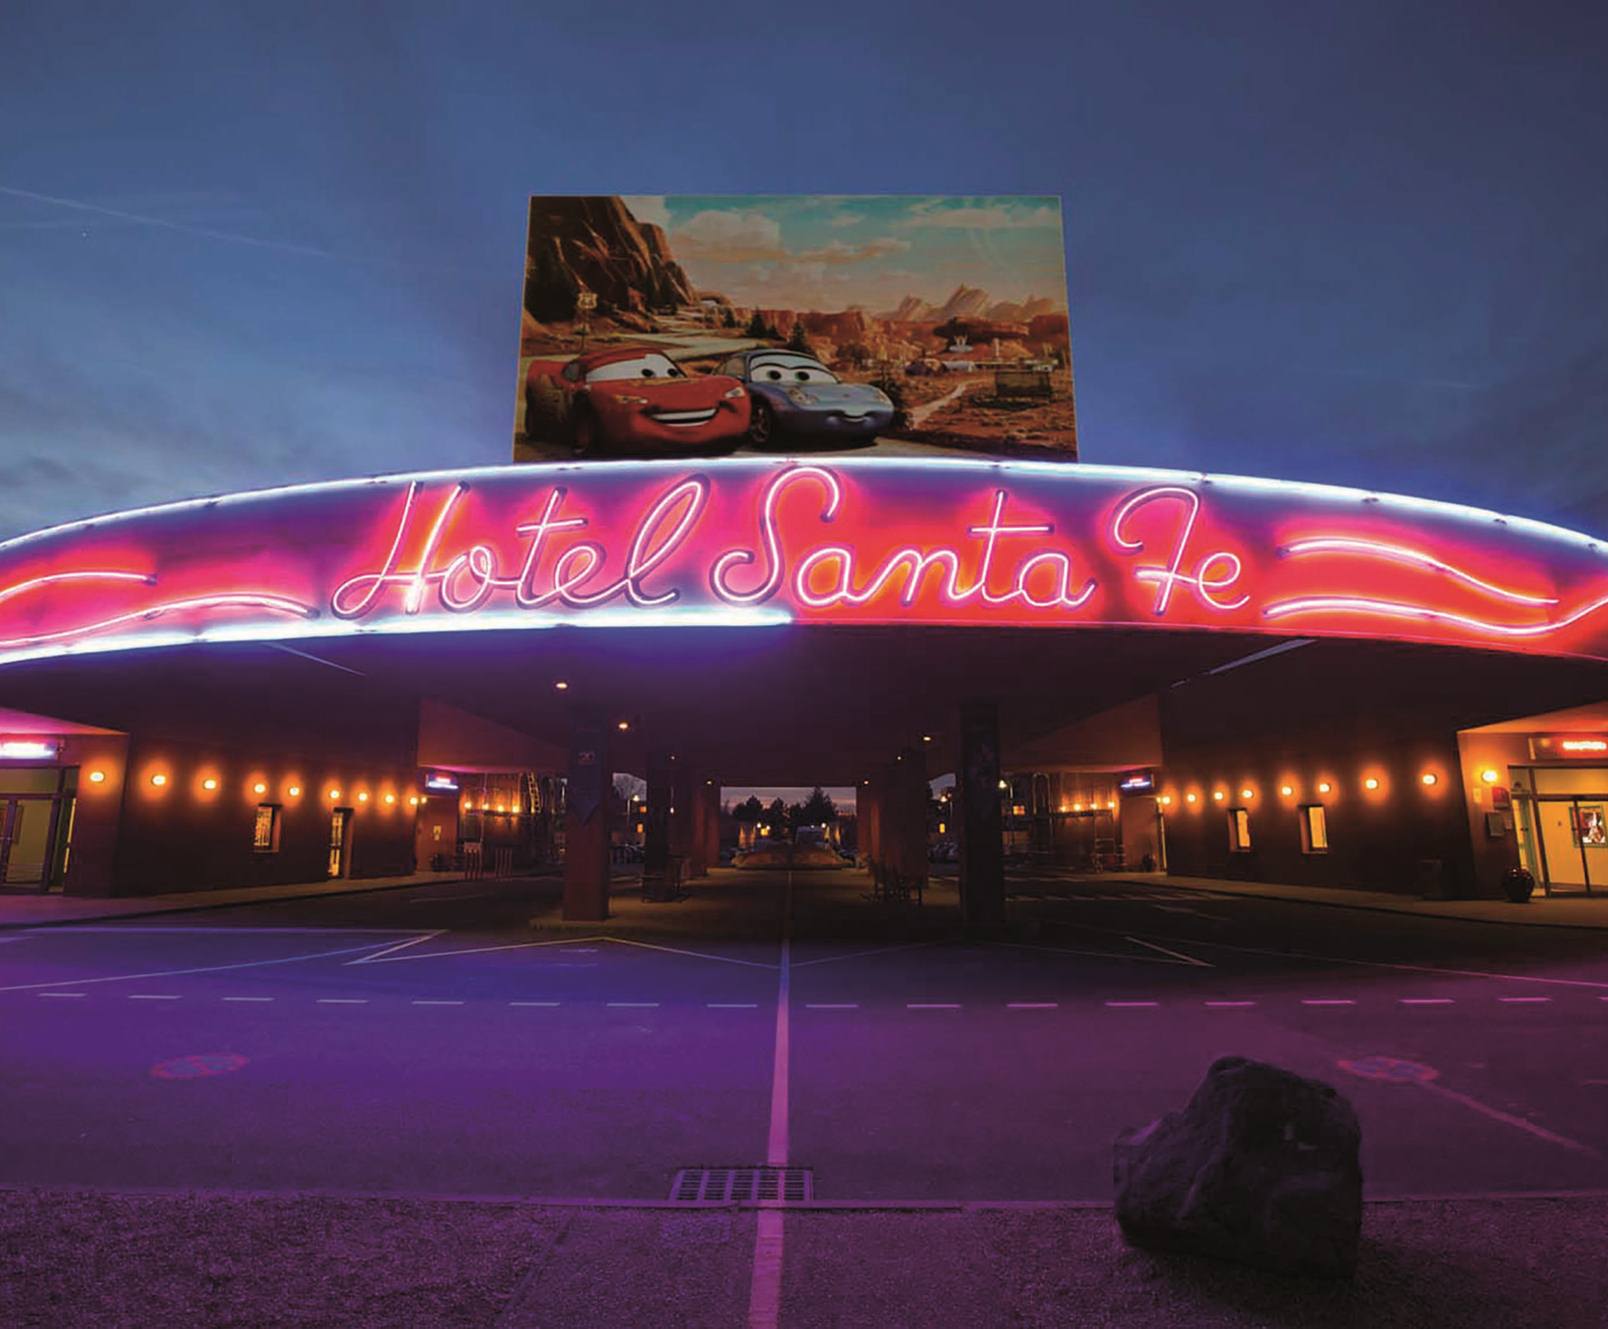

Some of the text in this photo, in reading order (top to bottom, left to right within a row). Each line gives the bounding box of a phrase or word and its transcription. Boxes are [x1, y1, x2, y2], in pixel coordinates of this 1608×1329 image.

[332, 465, 1251, 618] Hotel Santa Fe
